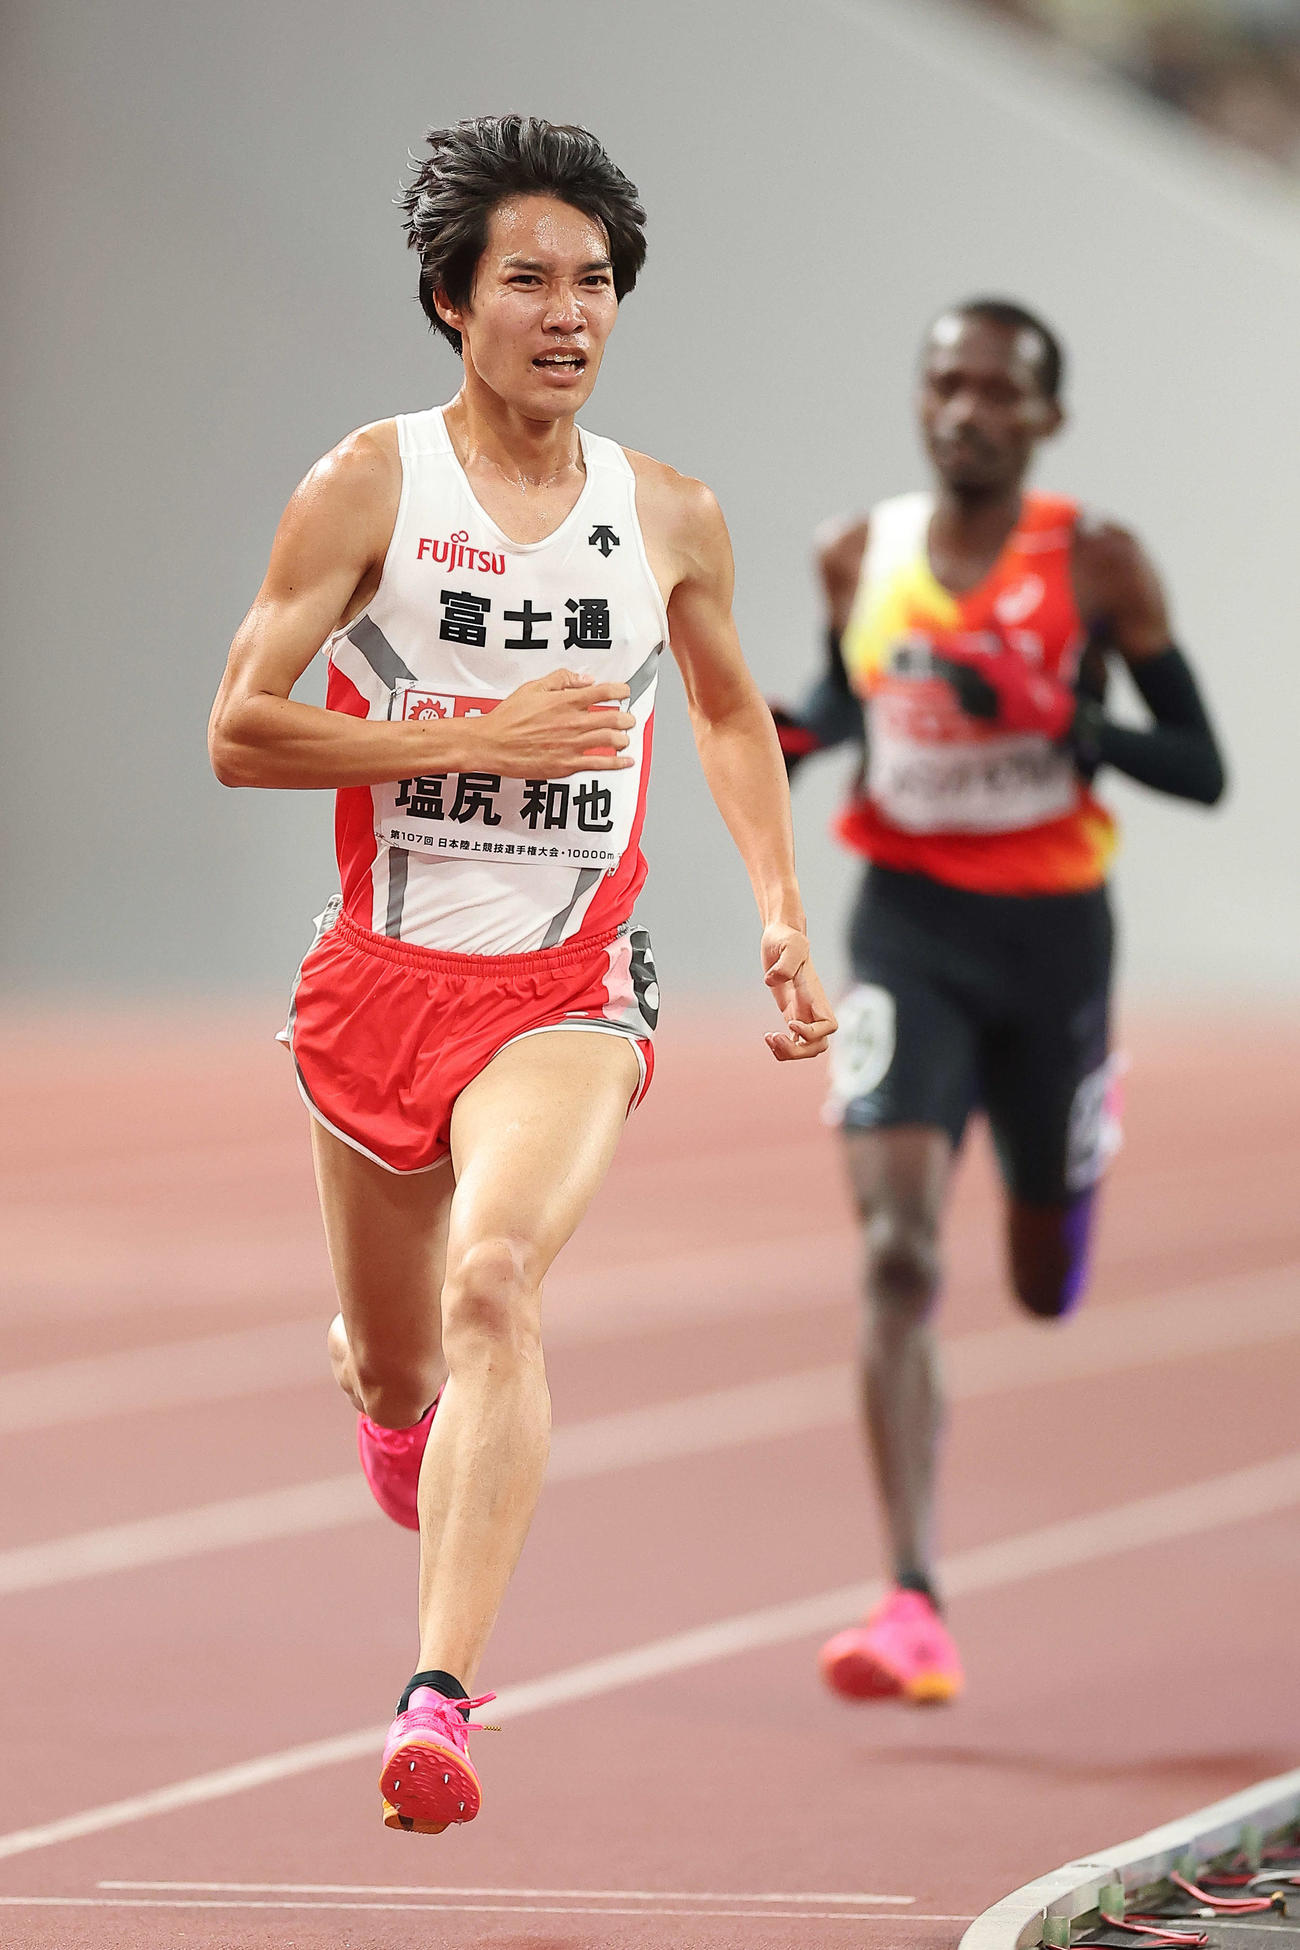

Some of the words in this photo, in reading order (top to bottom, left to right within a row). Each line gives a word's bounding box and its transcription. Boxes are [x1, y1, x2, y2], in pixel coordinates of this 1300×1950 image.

[417, 530, 506, 575] FUJITSU
[439, 589, 613, 651] 富士通
[395, 772, 502, 826] 塩尻
[519, 779, 614, 832] 和也
[390, 829, 434, 846] 第107回
